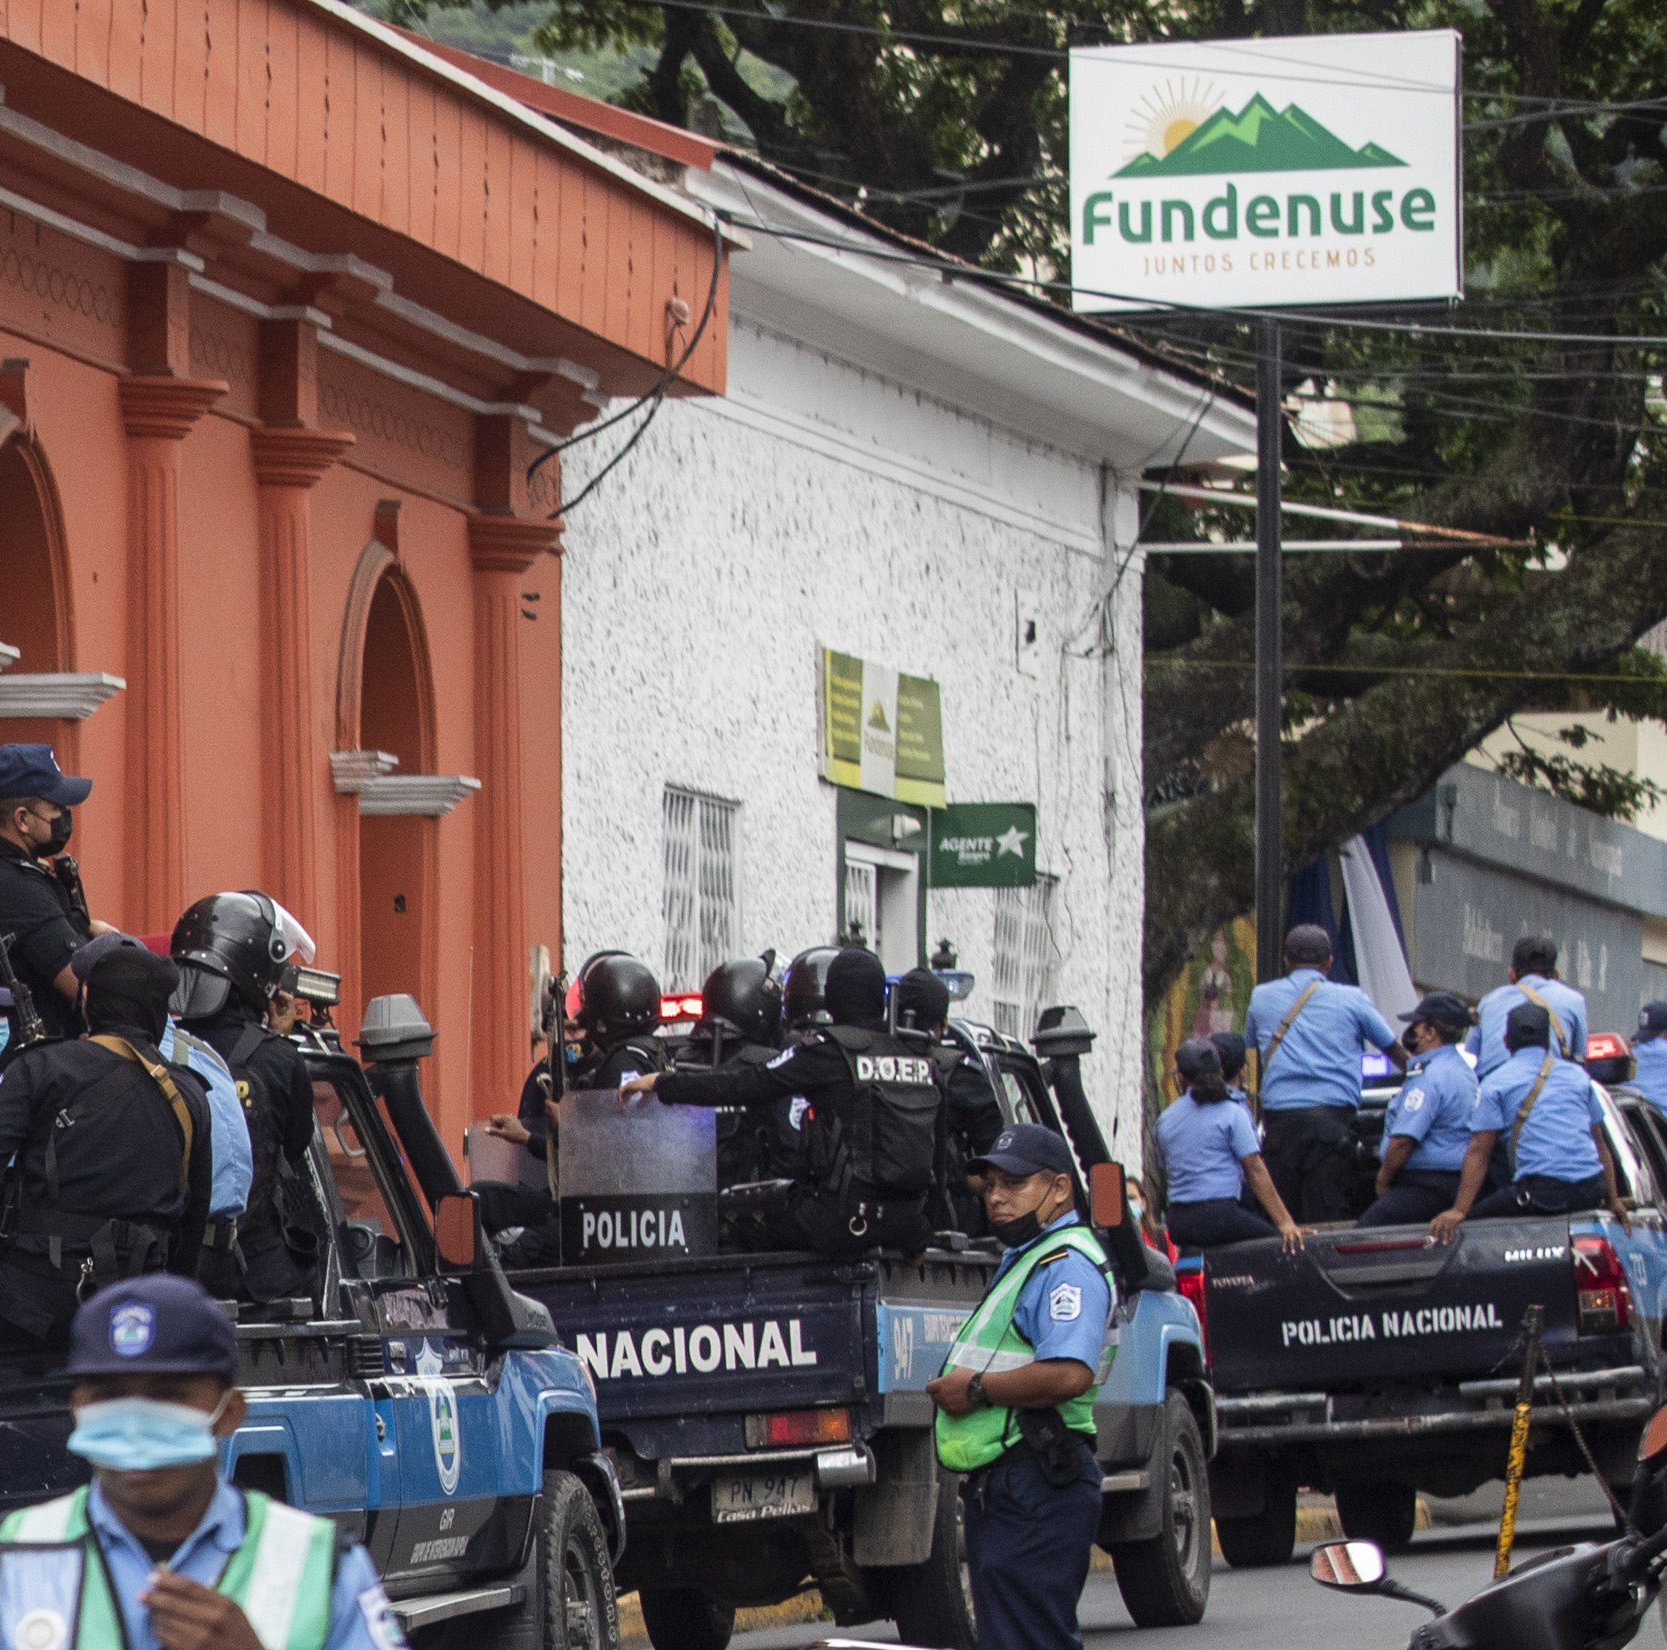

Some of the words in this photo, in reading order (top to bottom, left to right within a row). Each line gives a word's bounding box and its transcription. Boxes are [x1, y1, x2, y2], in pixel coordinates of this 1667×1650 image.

[1081, 181, 1437, 246] Fundenuse
[1144, 253, 1233, 276] JUNTOS
[1250, 247, 1376, 272] CRECEMOS
[939, 836, 994, 852] AGENTE
[857, 1055, 933, 1086] D.O.E.P.
[582, 1210, 686, 1249] POLICIA
[1281, 1313, 1376, 1347] POLICIA
[1382, 1303, 1503, 1338] NACIONAL
[576, 1320, 817, 1380] NACIONAL
[731, 1479, 753, 1502] PN
[764, 1477, 798, 1500] 947
